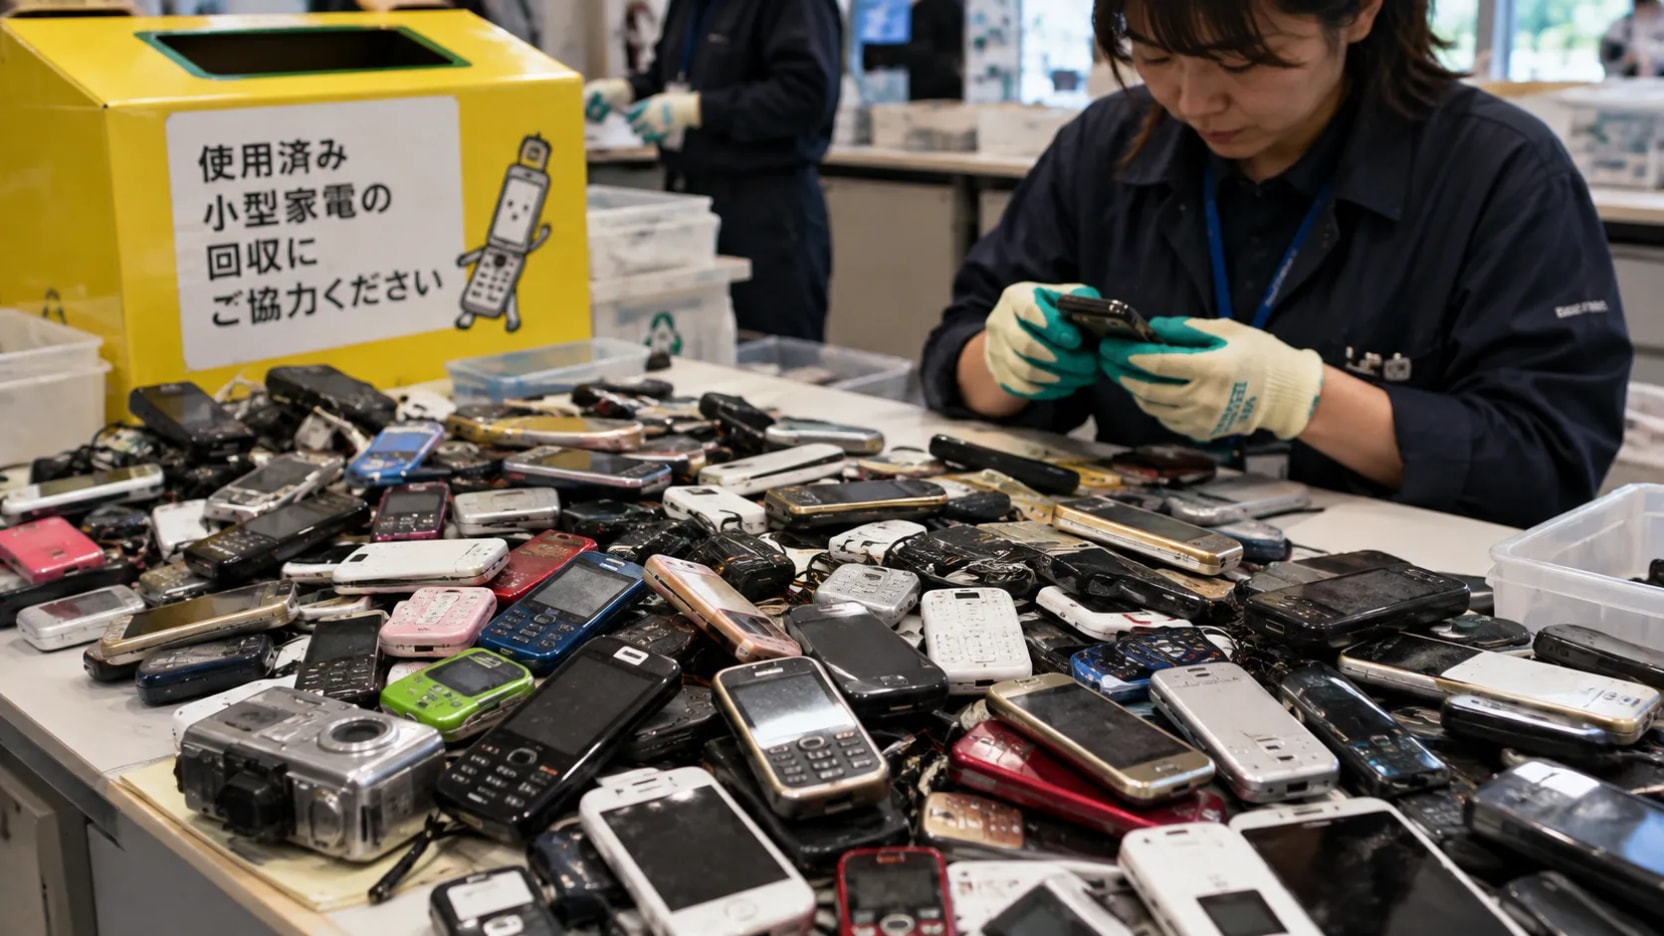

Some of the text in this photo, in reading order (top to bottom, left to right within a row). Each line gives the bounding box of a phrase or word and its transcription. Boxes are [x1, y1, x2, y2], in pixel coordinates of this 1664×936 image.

[198, 138, 348, 184] 使用済み
[203, 182, 393, 232] 小型家電の
[206, 237, 318, 281] 回収に
[212, 269, 443, 328] ご協力ください
